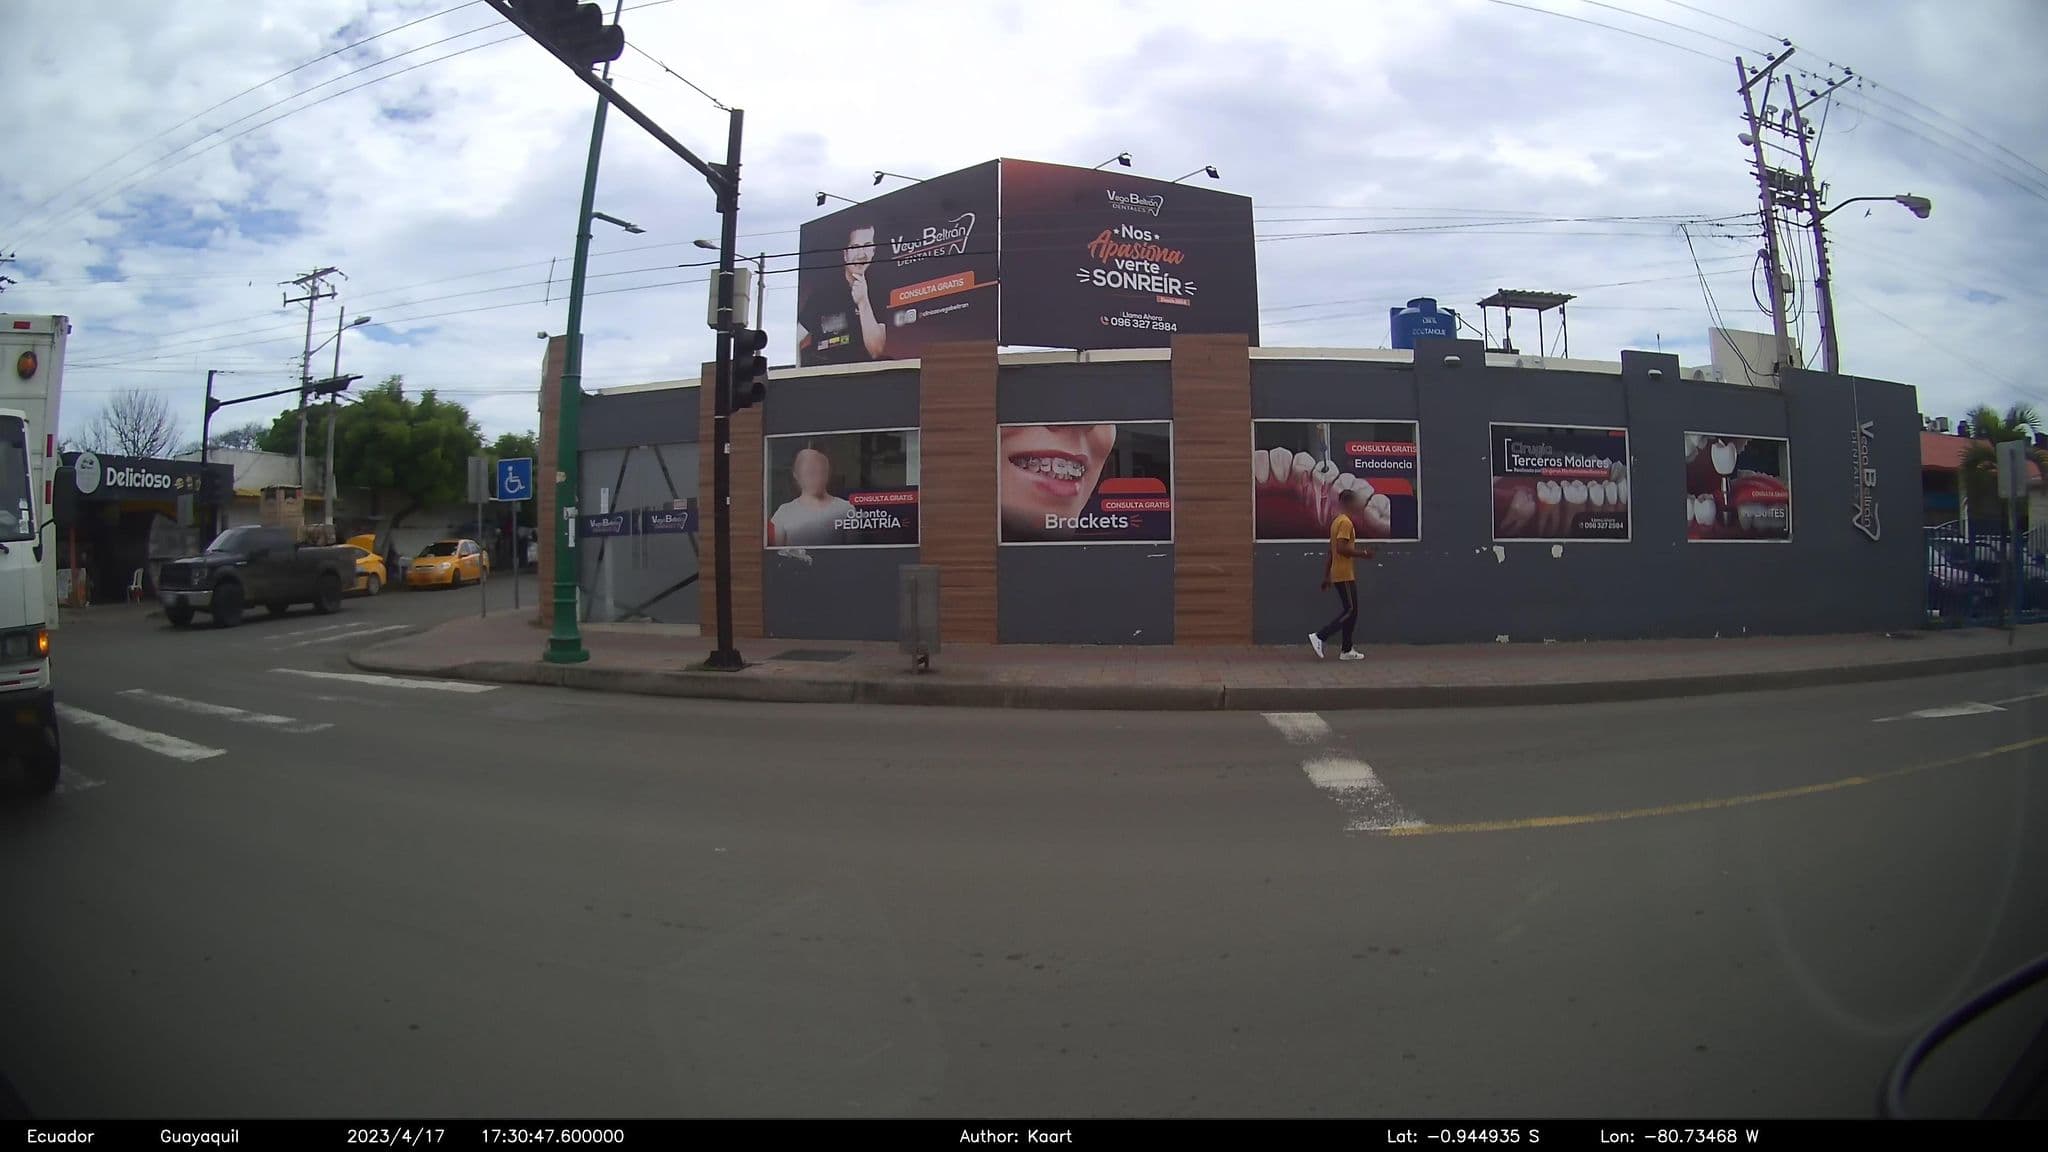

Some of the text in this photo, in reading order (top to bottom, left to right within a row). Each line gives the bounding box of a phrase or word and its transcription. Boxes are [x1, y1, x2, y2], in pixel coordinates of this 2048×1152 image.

[1121, 223, 1152, 241] Nos
[1088, 229, 1184, 264] Apasiona
[1115, 258, 1160, 274] verte
[899, 278, 964, 300] CONSULTA GRATIS
[1092, 268, 1182, 296] SONREÍR
[1132, 319, 1150, 329] 327
[1151, 321, 1177, 332] 2984
[1351, 444, 1391, 452] CONSULTA
[1354, 458, 1413, 469] Endodoncia
[1511, 454, 1609, 468] Terceros Molares
[106, 466, 171, 489] Delicioso
[854, 495, 889, 503] CONSULTA
[1105, 501, 1170, 509] CONSULTA GRATIS
[846, 508, 887, 519] Odonto
[1045, 513, 1129, 529] Brackets
[834, 514, 901, 530] PEDIATRÍA
